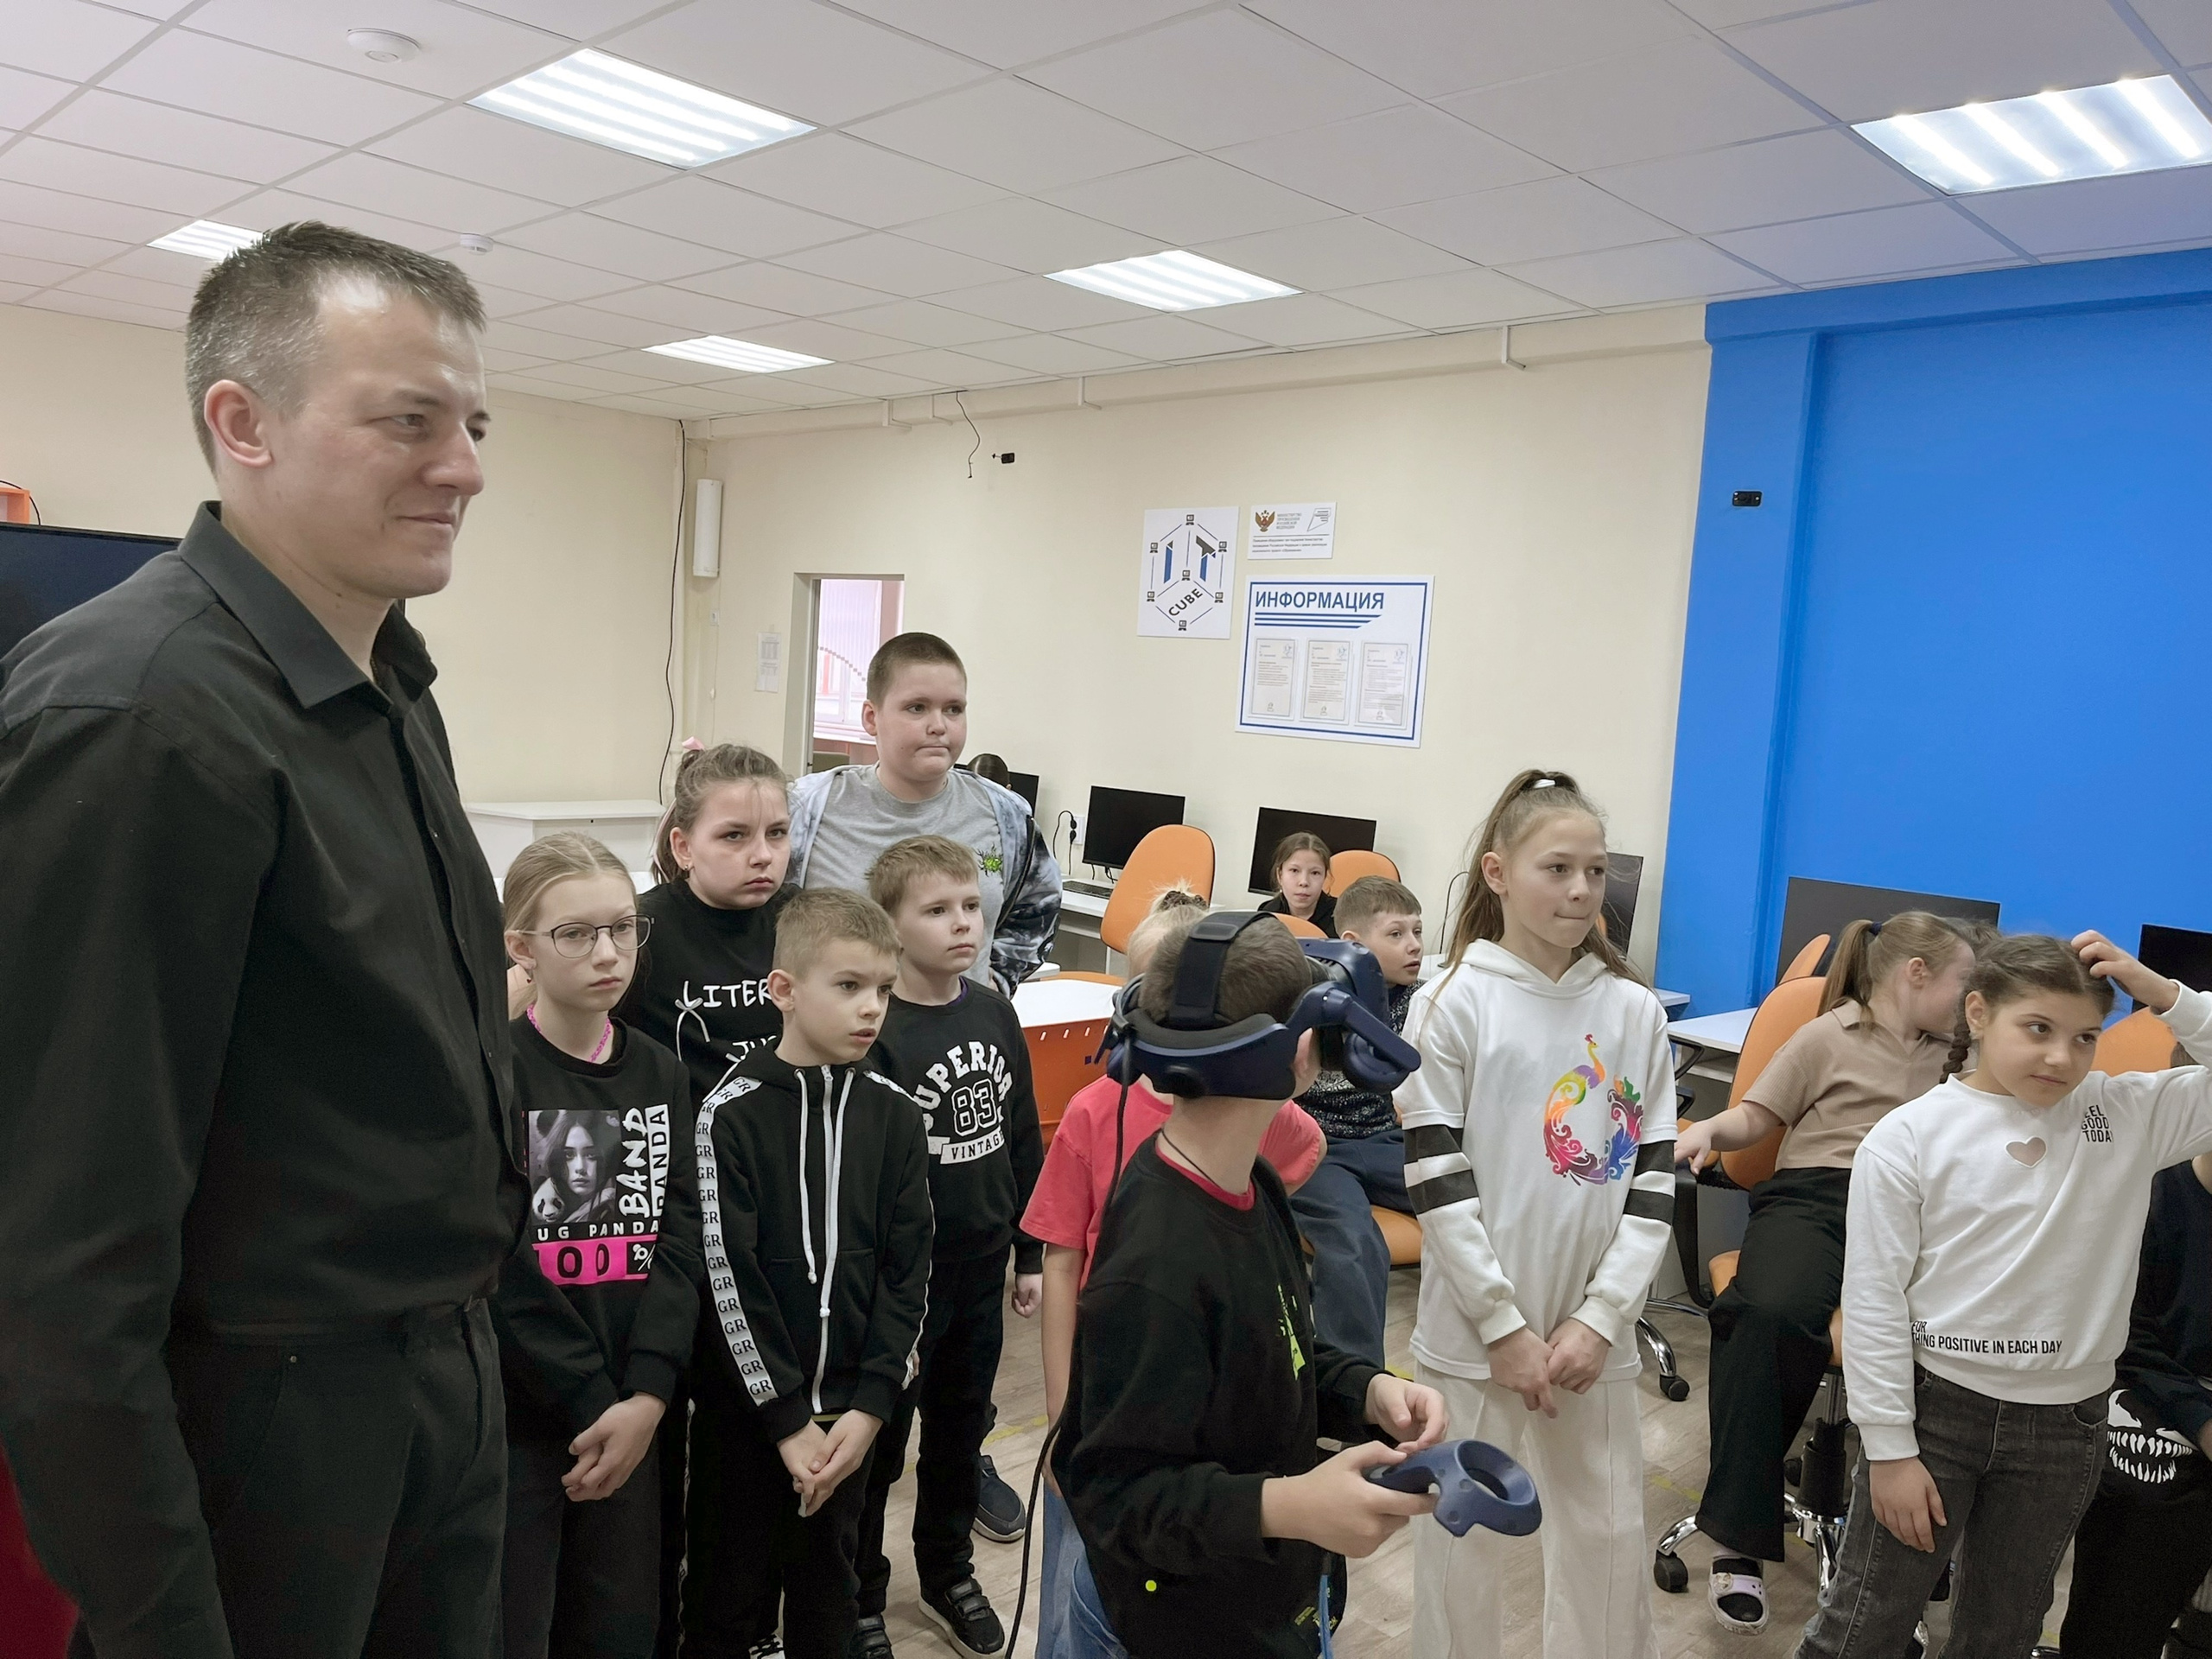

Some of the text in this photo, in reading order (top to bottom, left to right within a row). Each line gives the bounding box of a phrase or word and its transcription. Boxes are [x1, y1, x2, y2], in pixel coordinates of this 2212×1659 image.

[1168, 588, 1203, 616] CUBE
[1255, 590, 1384, 613] ИНФОРМАЦИЯ
[734, 1077, 751, 1092] GR
[951, 1078, 997, 1136] 83
[696, 1122, 709, 1135] GR
[2082, 1116, 2109, 1129] GOOD
[695, 1145, 712, 1157] GR
[616, 1108, 650, 1218] BAND
[696, 1166, 715, 1179] GR
[698, 1189, 716, 1201] GR
[702, 1211, 719, 1224] GR
[589, 1219, 659, 1237] PANDA
[704, 1234, 721, 1247] GR
[707, 1256, 728, 1269] GR
[713, 1276, 734, 1291] GR
[718, 1298, 740, 1313] GR
[724, 1319, 747, 1334] GR
[732, 1339, 754, 1355] GR
[1939, 1336, 1989, 1353] POSITIVE
[1993, 1340, 2005, 1354] IN
[2008, 1340, 2037, 1354] EACH
[2041, 1340, 2063, 1354] DAY
[741, 1359, 763, 1376] GR
[749, 1379, 772, 1395] GR
